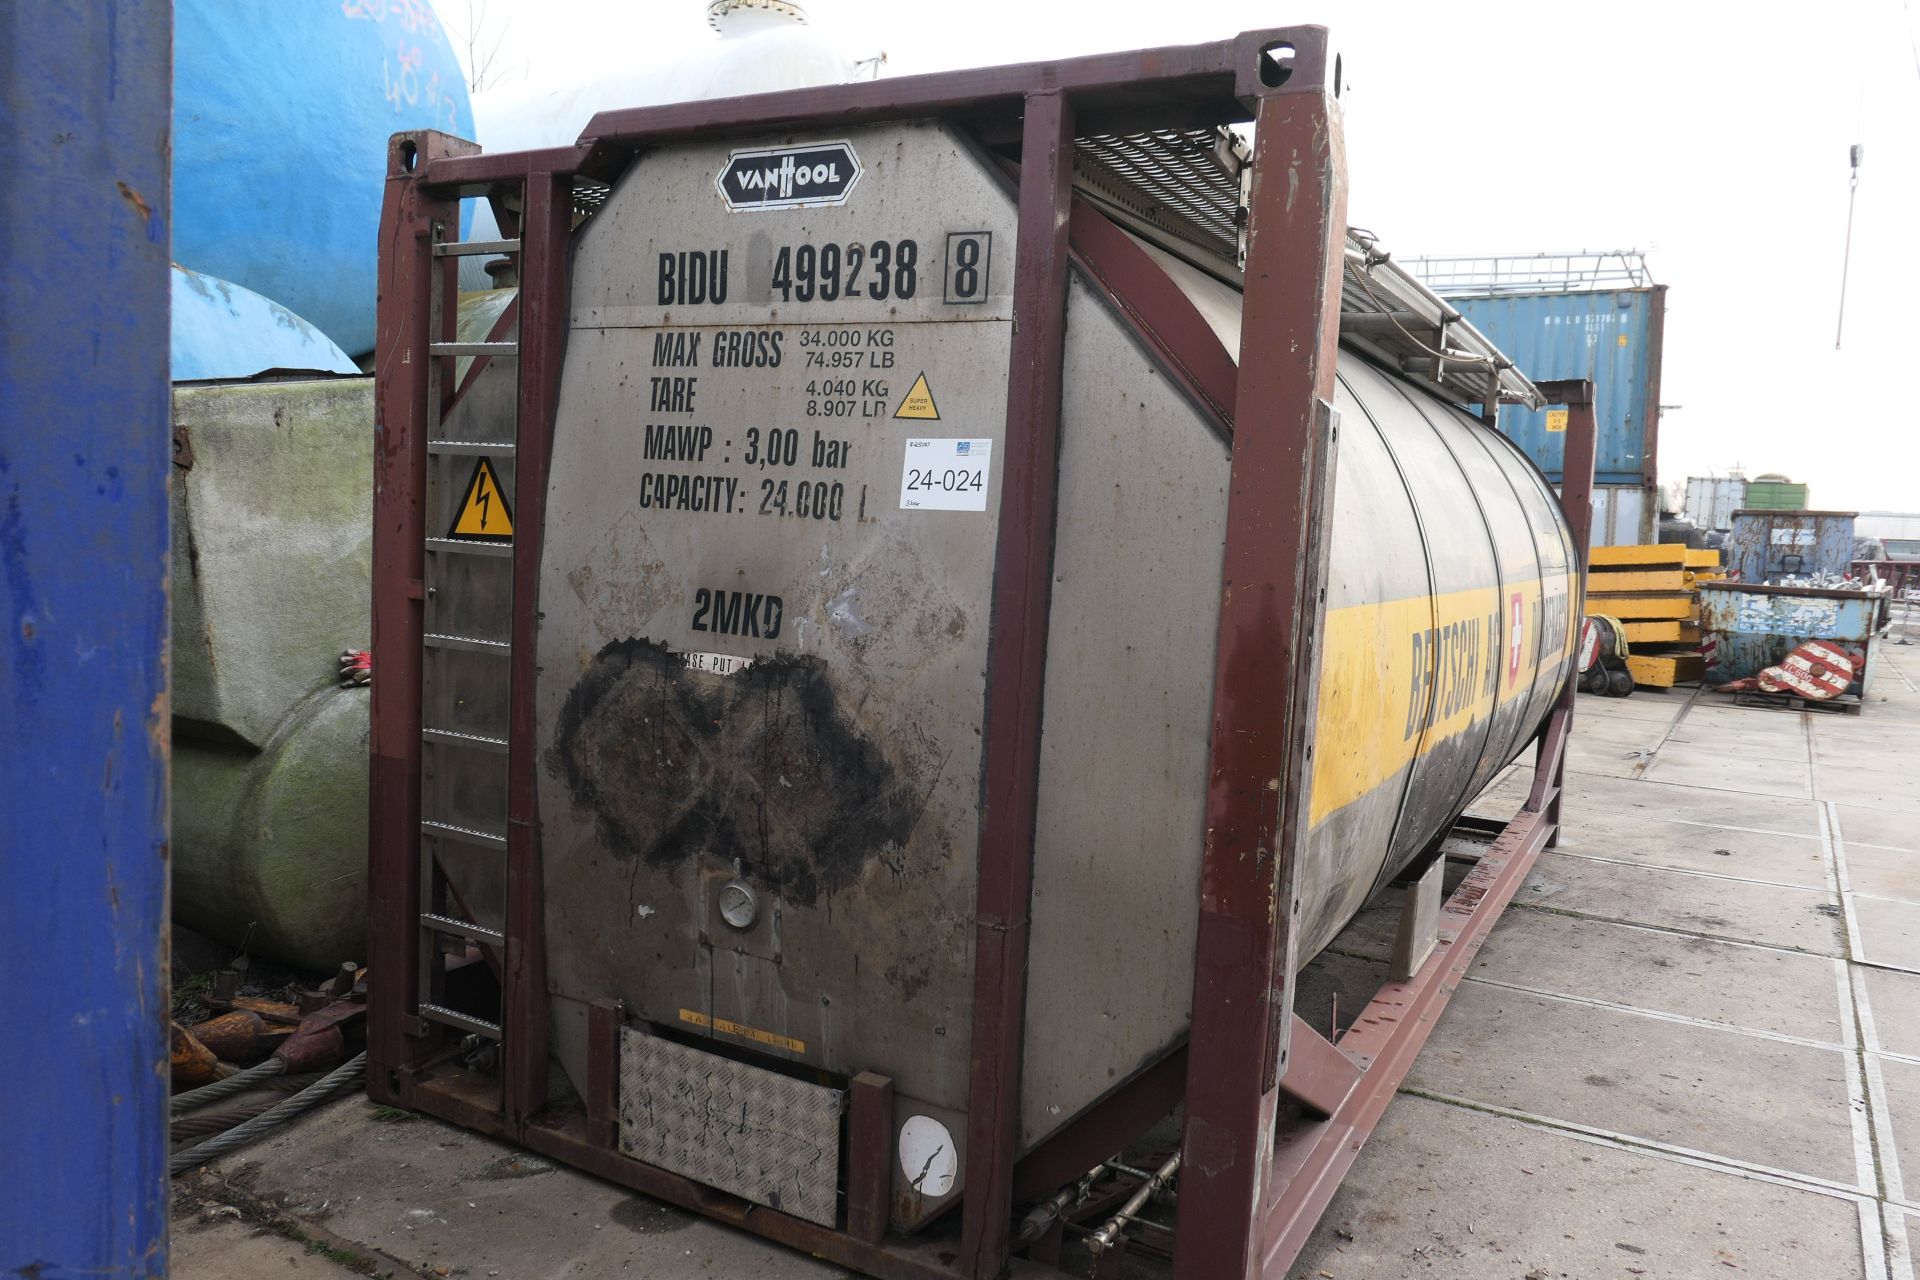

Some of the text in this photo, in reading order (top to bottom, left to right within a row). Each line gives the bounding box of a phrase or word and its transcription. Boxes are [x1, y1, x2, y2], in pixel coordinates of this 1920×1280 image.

[657, 238, 980, 305] BIDU 499238 8
[652, 330, 894, 369] MAX GROSS 34.000 KG
[805, 352, 895, 369] 74.957 LB
[650, 377, 889, 414] TARE 4.040 KG
[806, 400, 856, 417] 8.907
[643, 424, 713, 462] MAWP
[744, 427, 799, 471] 3,00
[811, 430, 852, 469] bar
[639, 472, 746, 514] CAPACITY:
[758, 478, 844, 521] 24.000
[907, 469, 982, 492] 24-024
[691, 587, 784, 640] 2MKD
[713, 656, 732, 673] PUT
[1404, 617, 1480, 742] BERTSCHI
